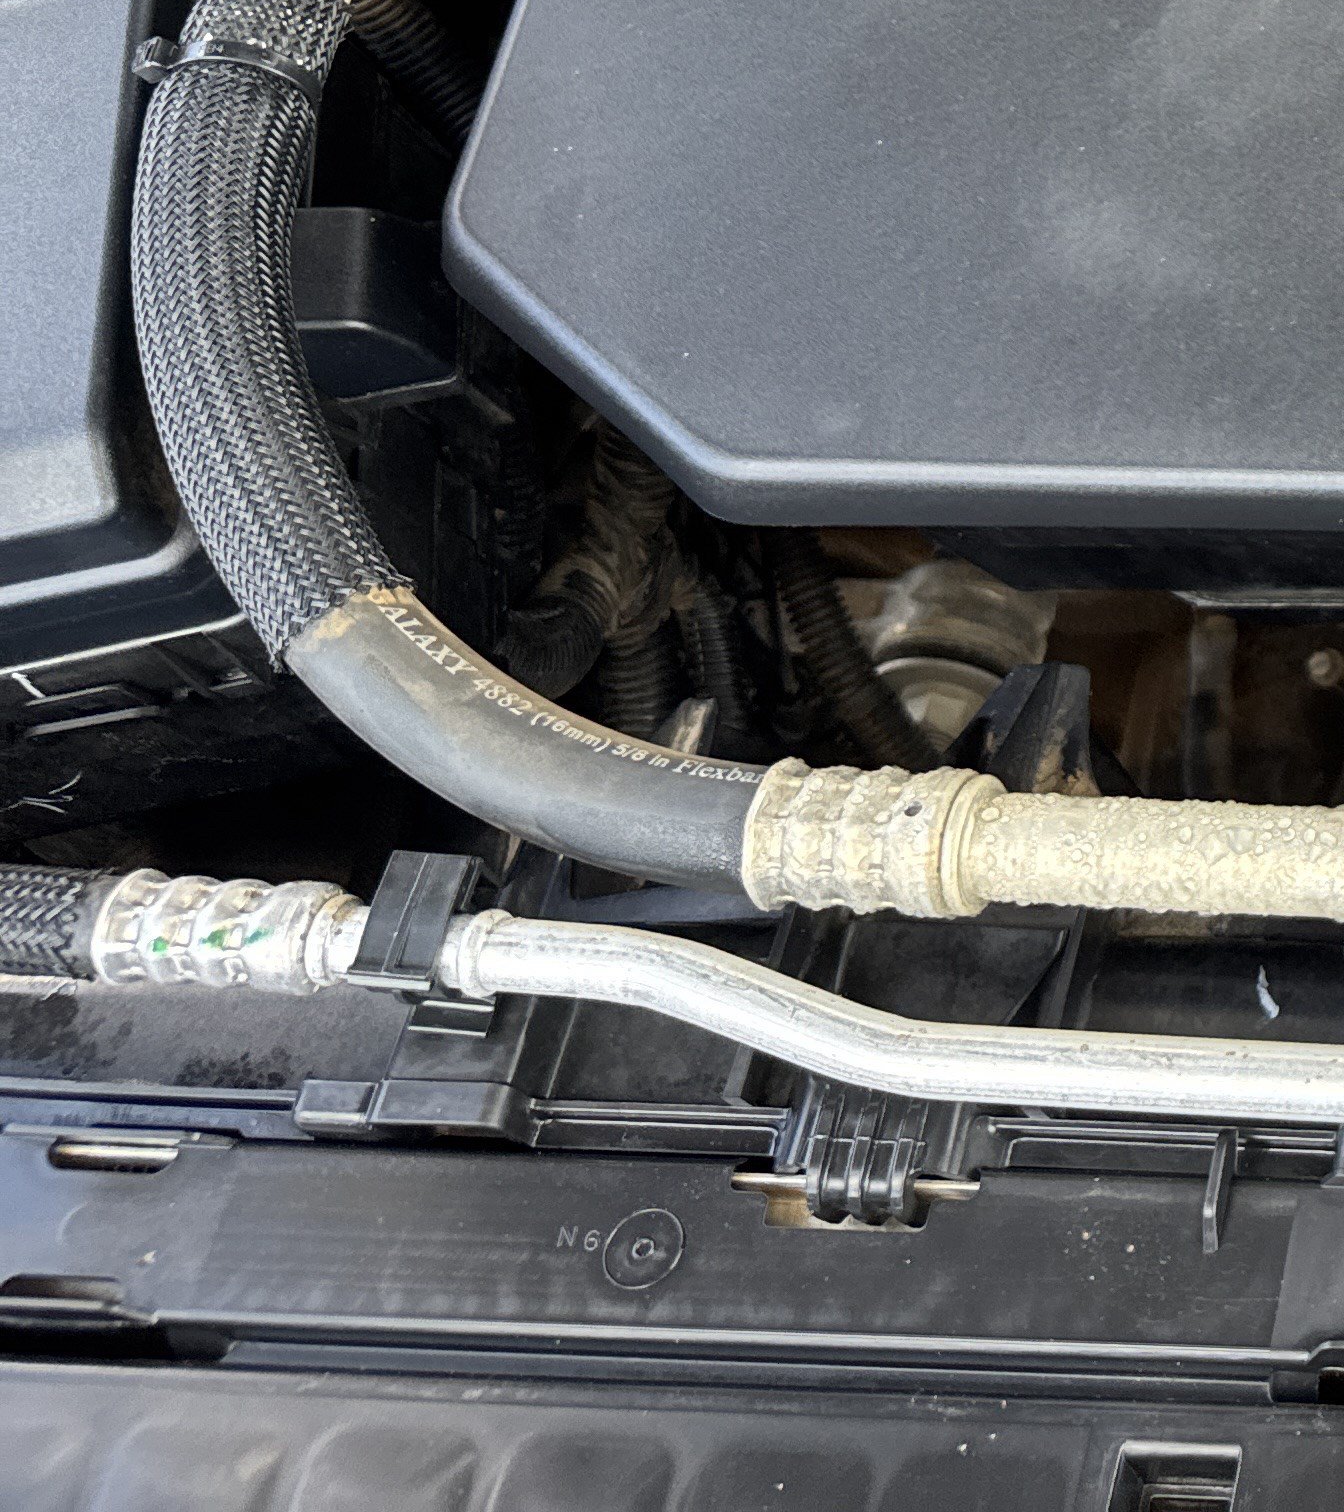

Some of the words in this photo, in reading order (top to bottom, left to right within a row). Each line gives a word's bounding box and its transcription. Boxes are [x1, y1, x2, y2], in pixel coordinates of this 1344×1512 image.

[473, 676, 535, 716] 4882
[530, 710, 613, 753] (16mm)
[648, 753, 670, 768] in
[556, 1225, 601, 1251] N6
